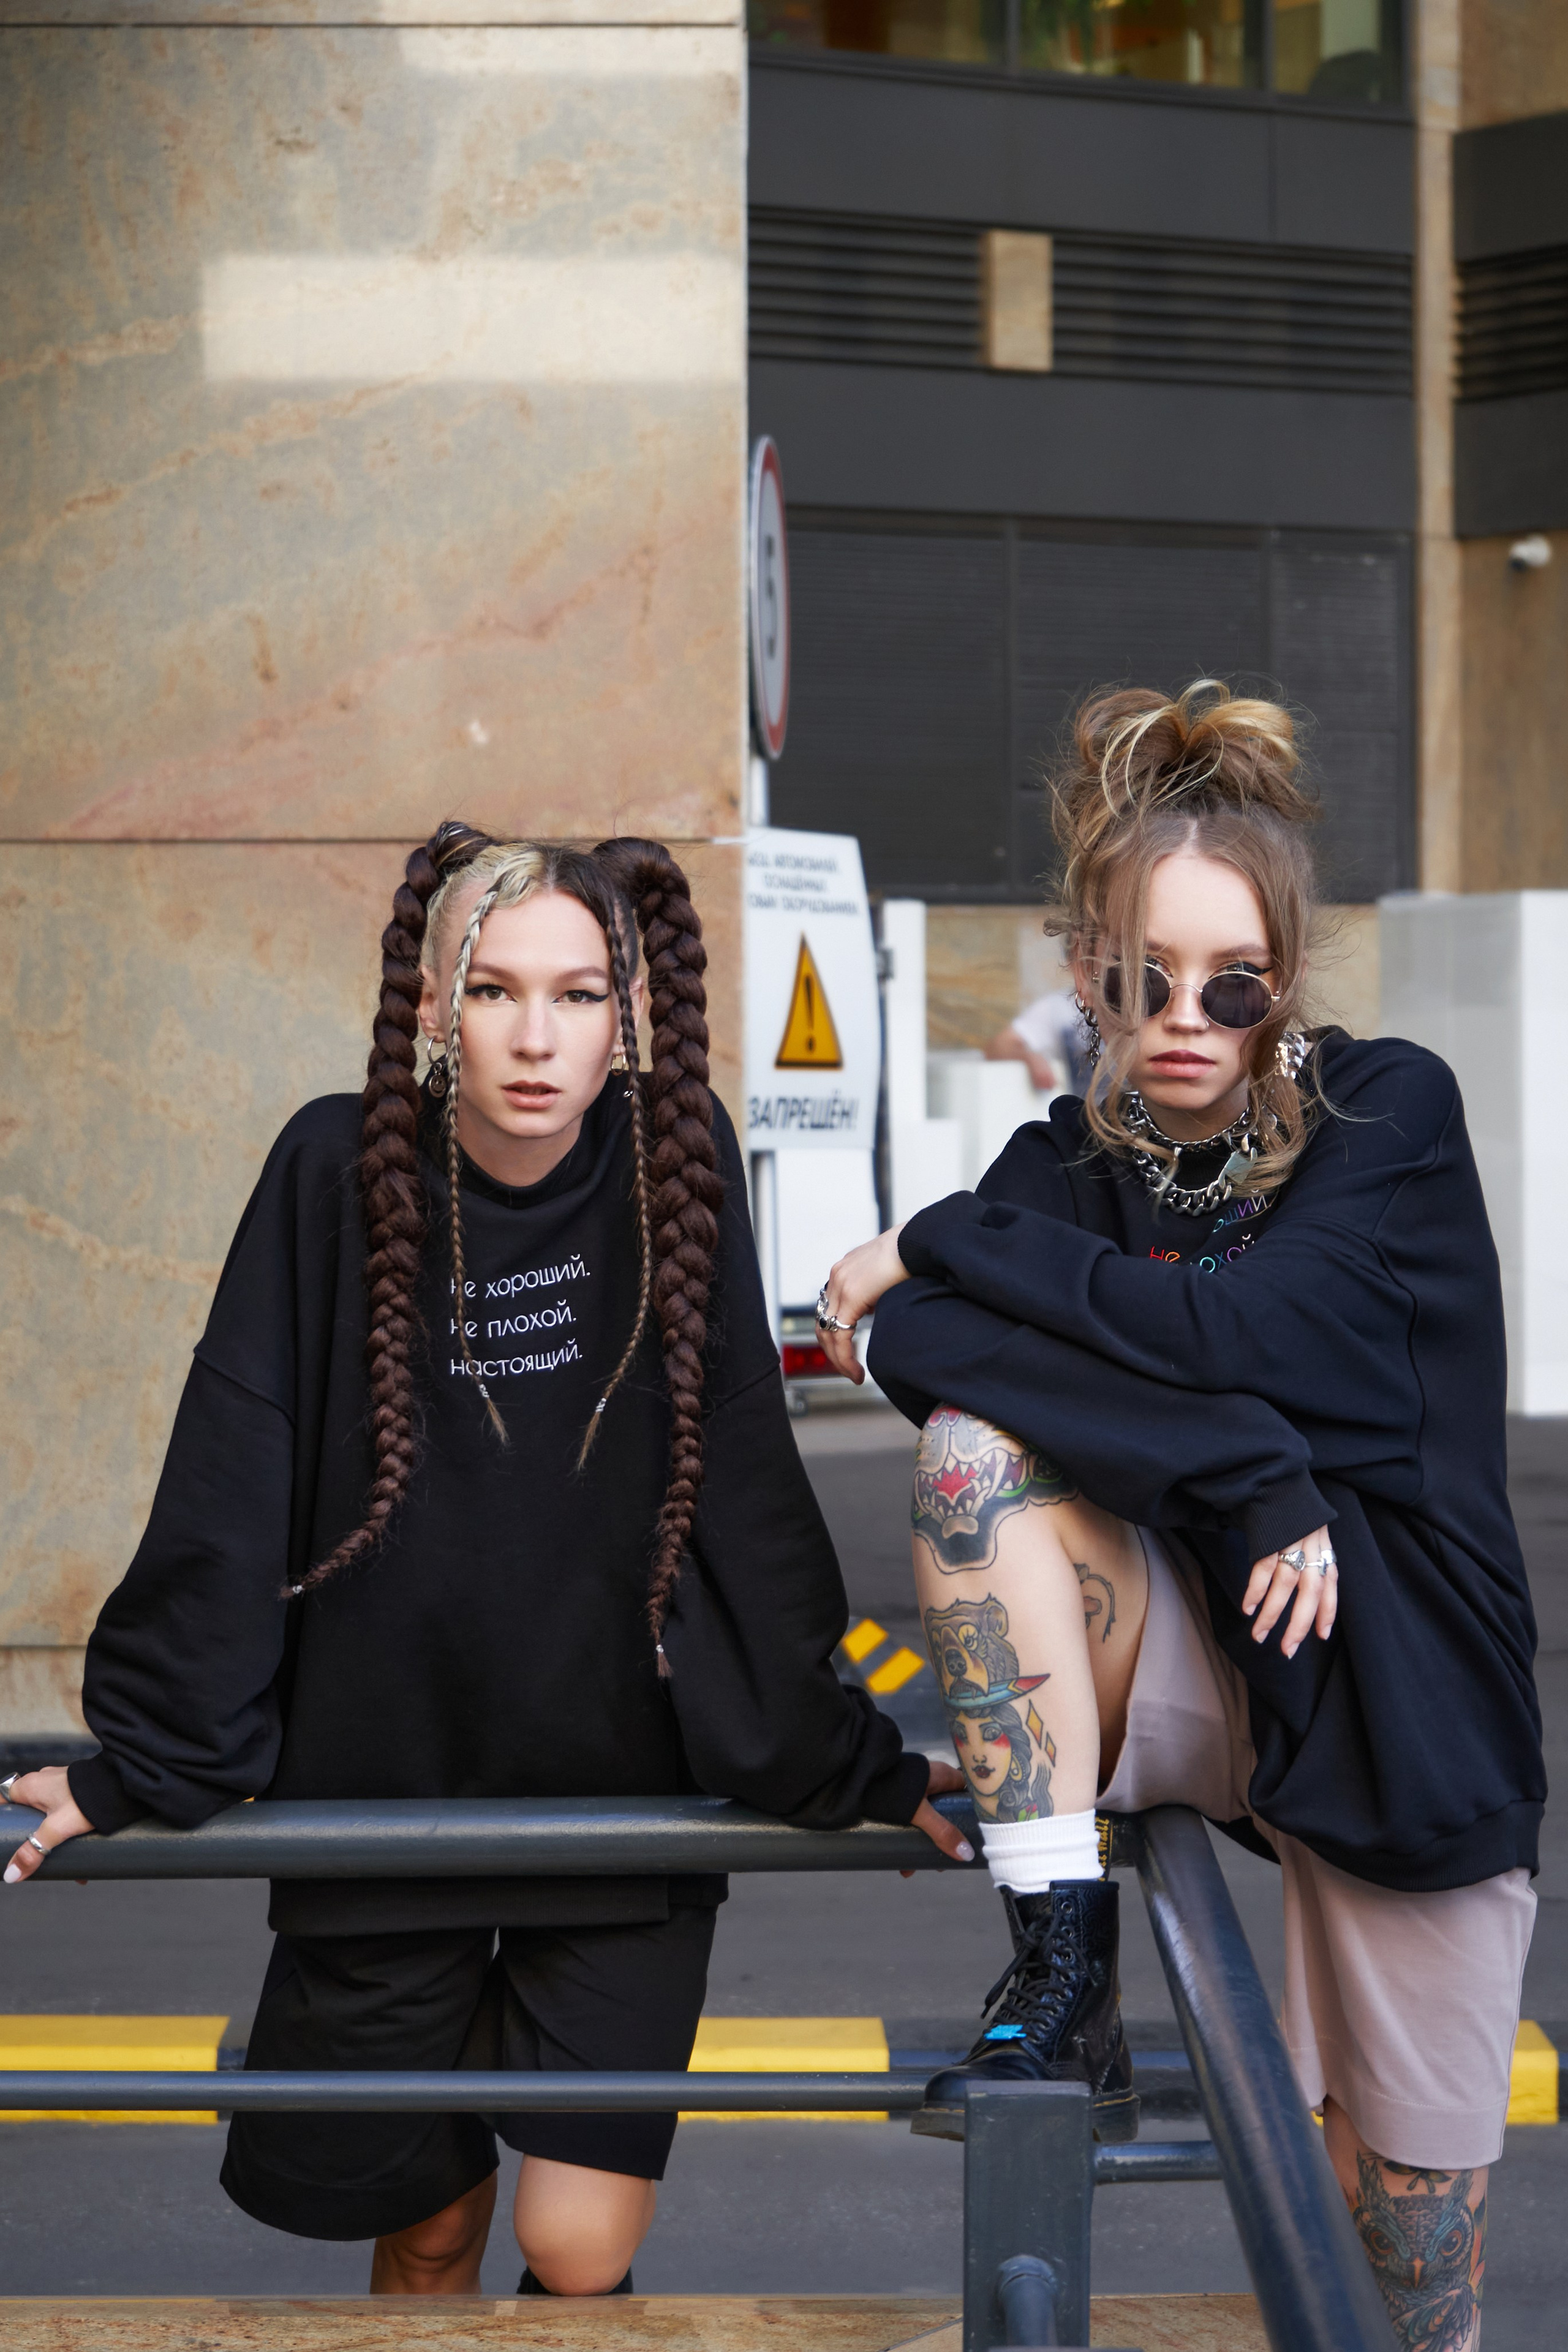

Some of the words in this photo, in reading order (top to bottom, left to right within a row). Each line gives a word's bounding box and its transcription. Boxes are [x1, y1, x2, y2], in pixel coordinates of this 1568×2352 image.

[485, 1253, 591, 1298] хороший.
[488, 1298, 577, 1338] плохой.
[450, 1338, 583, 1376] настоящий.
